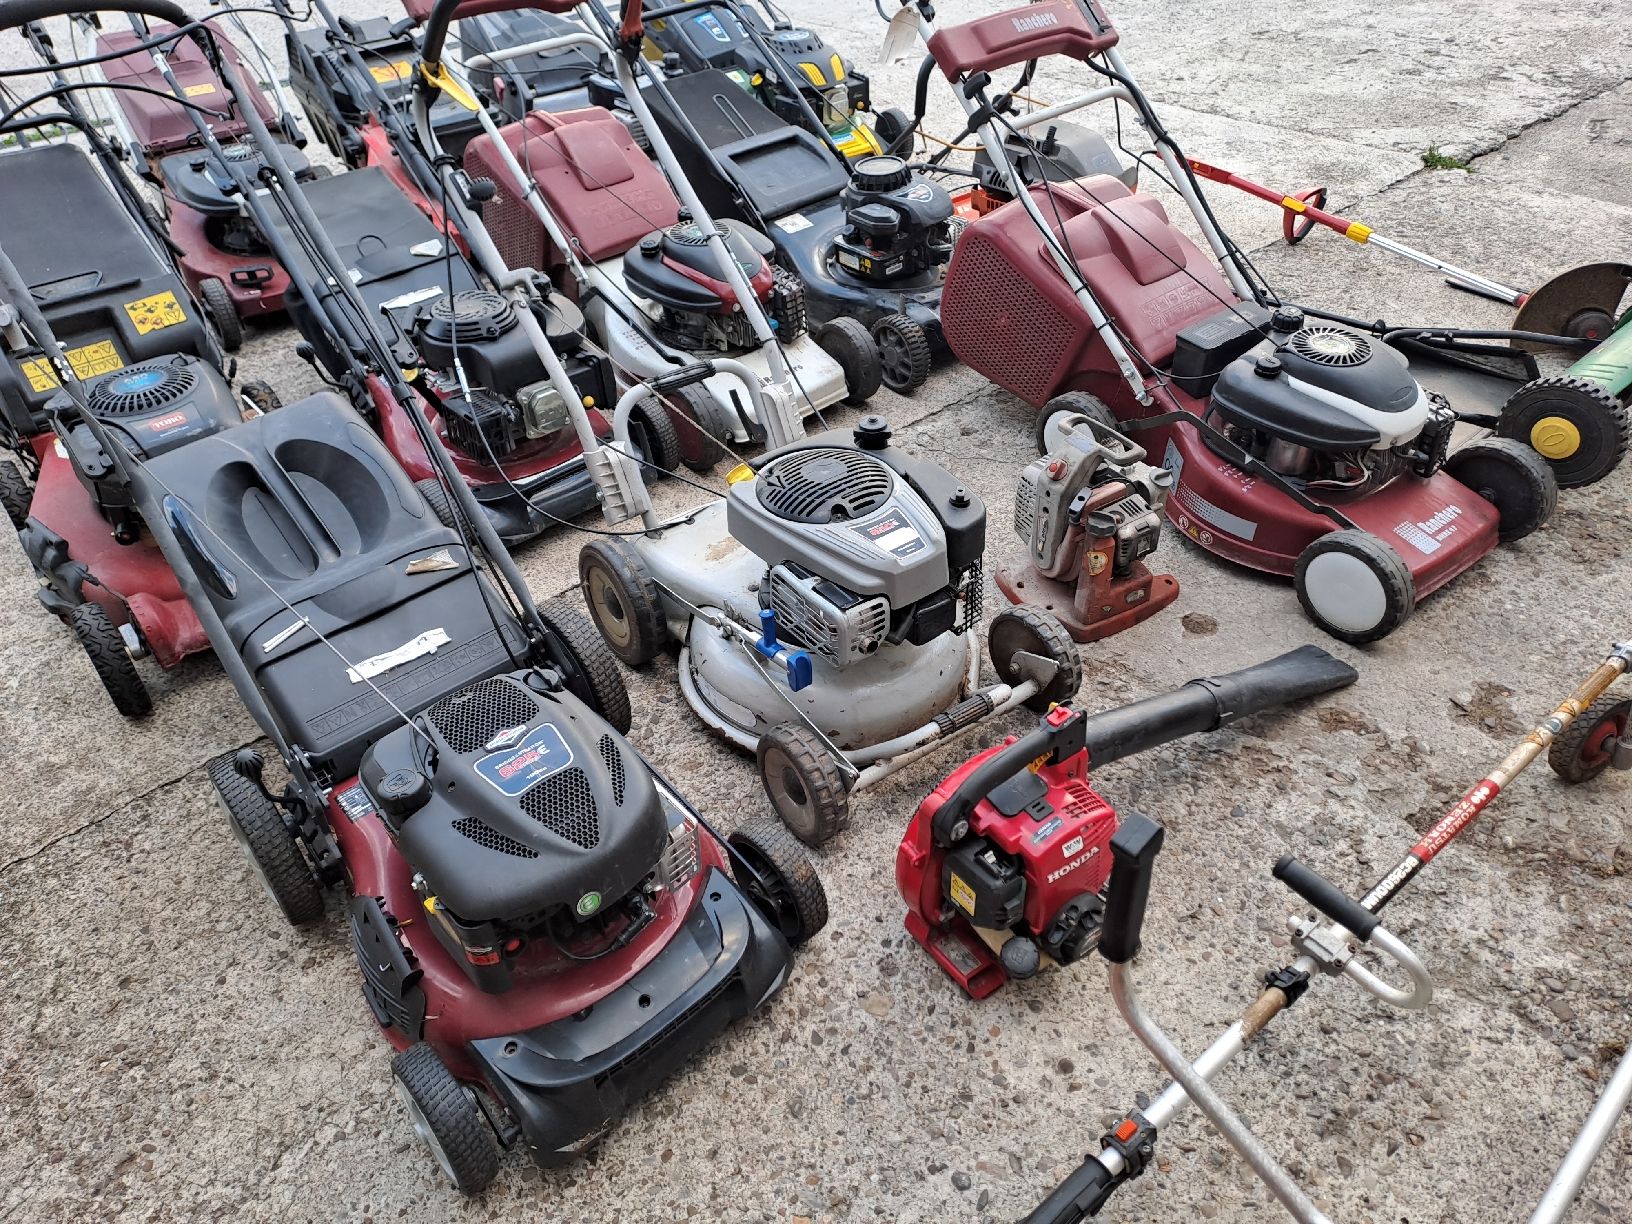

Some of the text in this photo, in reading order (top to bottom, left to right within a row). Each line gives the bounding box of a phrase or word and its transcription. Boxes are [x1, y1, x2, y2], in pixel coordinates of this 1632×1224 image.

[1011, 13, 1058, 33] Ranchero
[153, 415, 182, 428] TORO
[1417, 504, 1462, 534] Ranchero
[1420, 800, 1470, 848] ZENOAH
[1428, 805, 1476, 854] KOMATSU
[1047, 846, 1100, 884] HONDA
